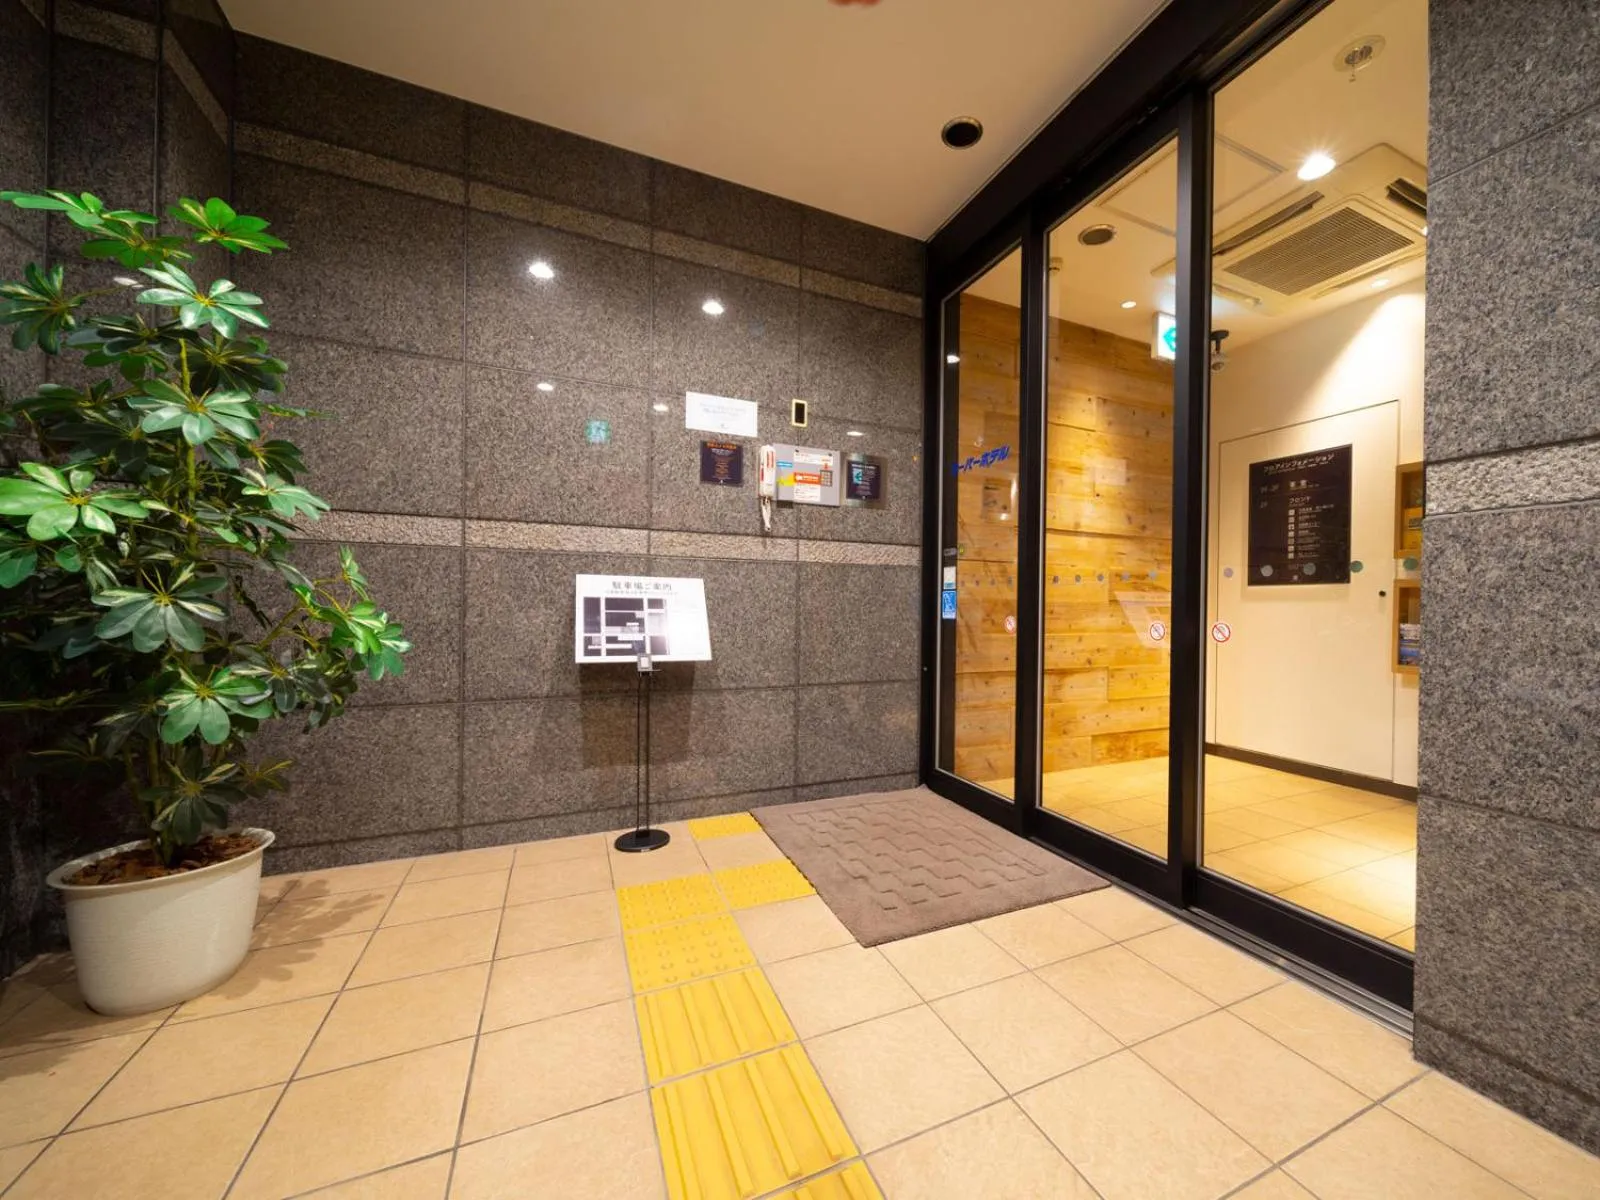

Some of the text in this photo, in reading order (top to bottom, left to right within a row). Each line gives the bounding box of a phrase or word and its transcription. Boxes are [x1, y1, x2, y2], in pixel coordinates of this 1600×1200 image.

[952, 445, 1009, 476] ーパーホテル
[612, 580, 672, 591] 駐車場ご案内
